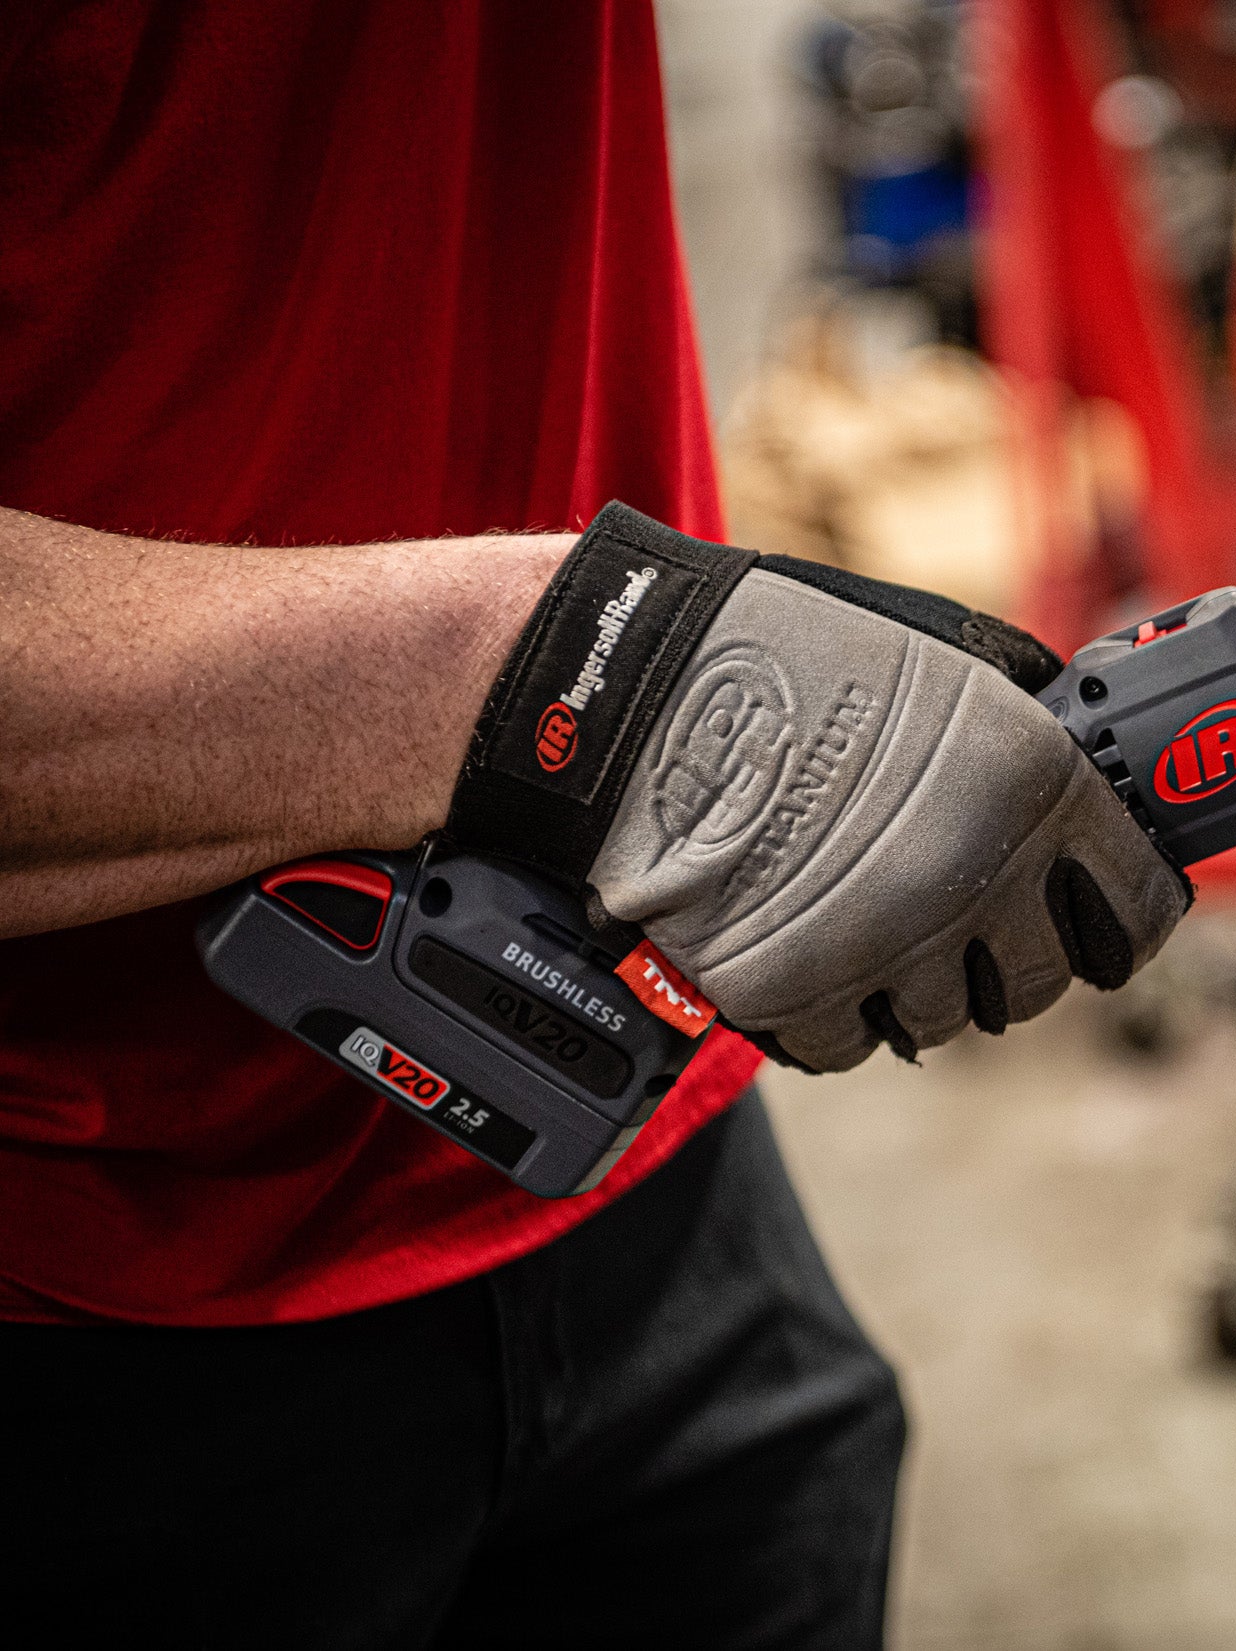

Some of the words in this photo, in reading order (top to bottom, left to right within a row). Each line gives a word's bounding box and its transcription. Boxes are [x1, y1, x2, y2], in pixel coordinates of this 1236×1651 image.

[535, 712, 576, 766] IR
[722, 680, 878, 890] TITANIUM
[501, 942, 627, 1033] BRUSHLESS
[642, 957, 703, 1018] TNT
[482, 986, 589, 1062] IQV20
[351, 1034, 440, 1100] IQV20
[449, 1097, 491, 1128] 2.5
